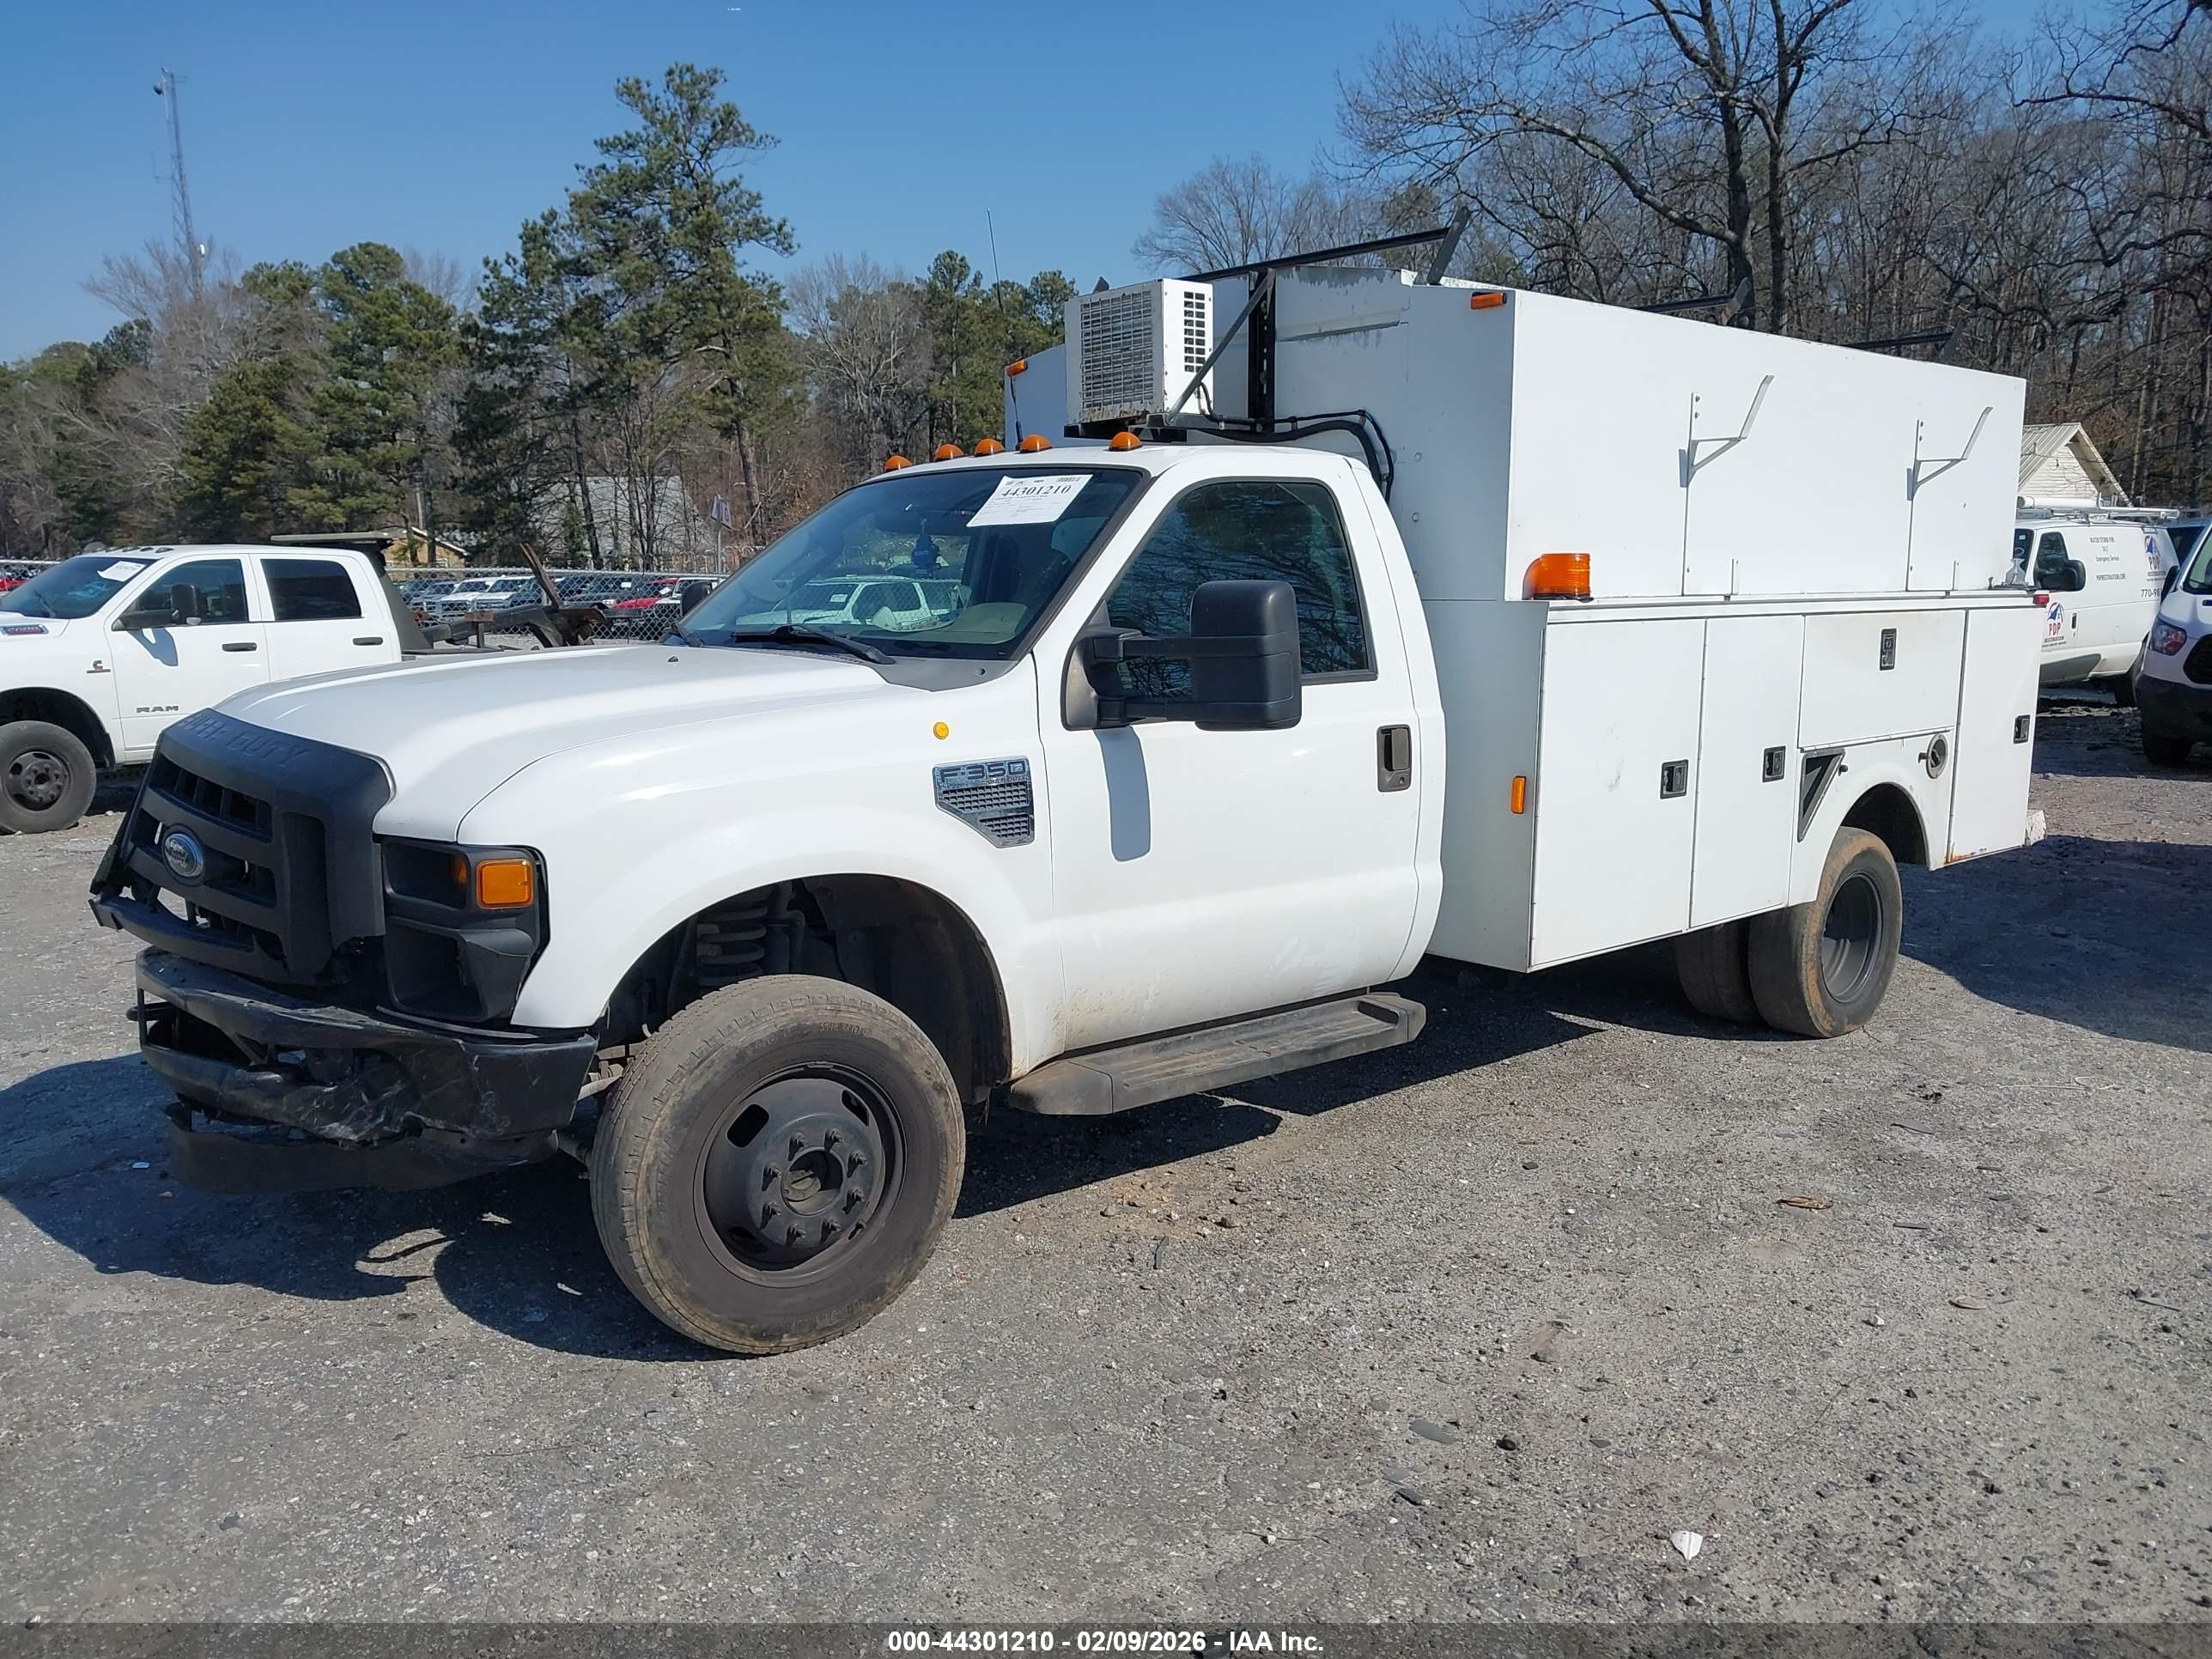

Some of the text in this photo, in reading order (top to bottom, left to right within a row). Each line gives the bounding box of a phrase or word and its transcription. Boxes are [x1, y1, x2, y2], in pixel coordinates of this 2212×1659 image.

[1001, 484, 1073, 497] 44301210
[2148, 556, 2160, 570] PDP
[2049, 623, 2061, 636] PDP
[136, 705, 179, 714] RAM
